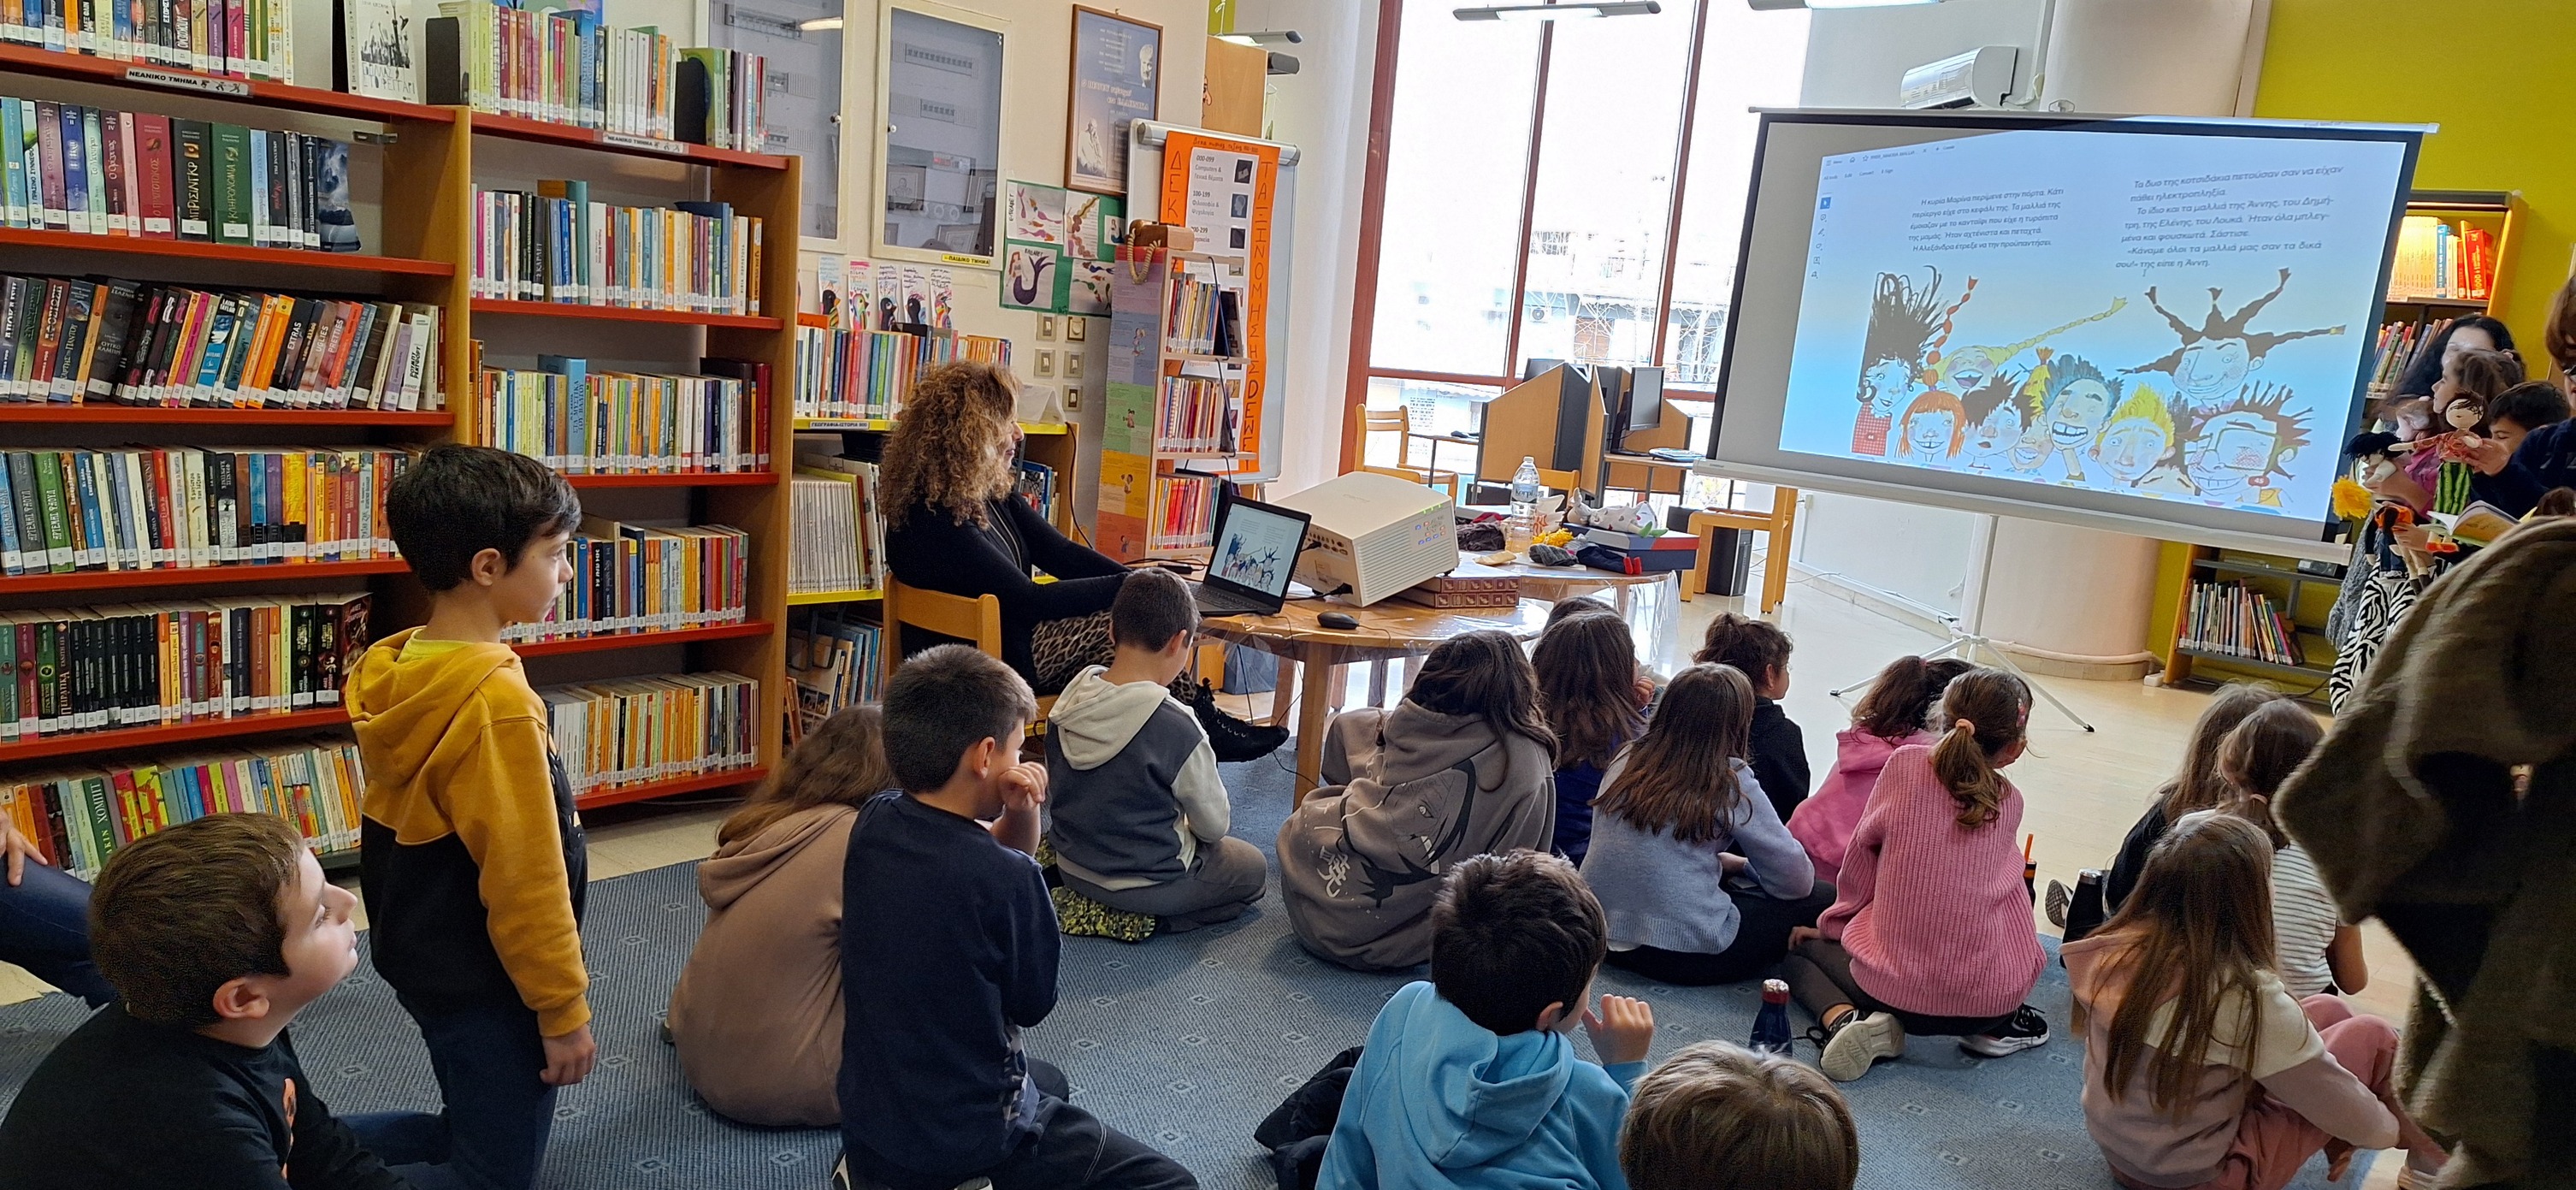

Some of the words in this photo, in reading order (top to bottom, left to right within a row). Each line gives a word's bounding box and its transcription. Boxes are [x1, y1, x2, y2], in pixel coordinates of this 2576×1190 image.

[128, 69, 167, 82] ΝΕΑΝΙΚΟ
[168, 75, 198, 86] ΤΜΗΜΑ
[1196, 164, 1216, 173] Computers
[2181, 175, 2230, 185] κοτσιδάκια
[2232, 170, 2280, 180] πετούσαν
[2315, 165, 2344, 176] είχαν
[1192, 190, 1211, 198] 100-199
[2130, 193, 2154, 202] πάθει
[1912, 210, 1941, 219] περίεργο
[1970, 204, 1994, 214] κεφάλι
[2020, 202, 2046, 210] μαλλιά
[2148, 205, 2165, 214] ίδιο
[2193, 202, 2227, 213] μαλλιά
[2229, 202, 2246, 210] της
[2275, 212, 2294, 221] όλα
[2003, 216, 2017, 224] είχε
[2025, 214, 2059, 222] τυρόπιτα
[1919, 243, 1954, 252] Αλεξάνδρα
[1955, 241, 1977, 250] έτρεξε
[2121, 234, 2142, 243] μένα
[2166, 245, 2187, 253] όλοι
[2203, 243, 2236, 253] μαλλιά
[2239, 244, 2260, 252] μας
[2299, 240, 2322, 250] δικά
[1249, 161, 1273, 374] ΤΑΞΙΝΟΜΗΣΗΣ
[220, 304, 236, 314] TAYLOR
[65, 323, 78, 351] ΠΑΝΤΟΥ
[287, 321, 302, 351] EXTRAS
[315, 325, 328, 352] UGLIES
[328, 319, 344, 353] PRETTIES
[59, 671, 72, 715] ΠΕΙΡΑΤΙΚΑ
[89, 783, 108, 825] ΧΟΜΠΙΤ
[101, 830, 113, 855] ΛΚΙΝ
